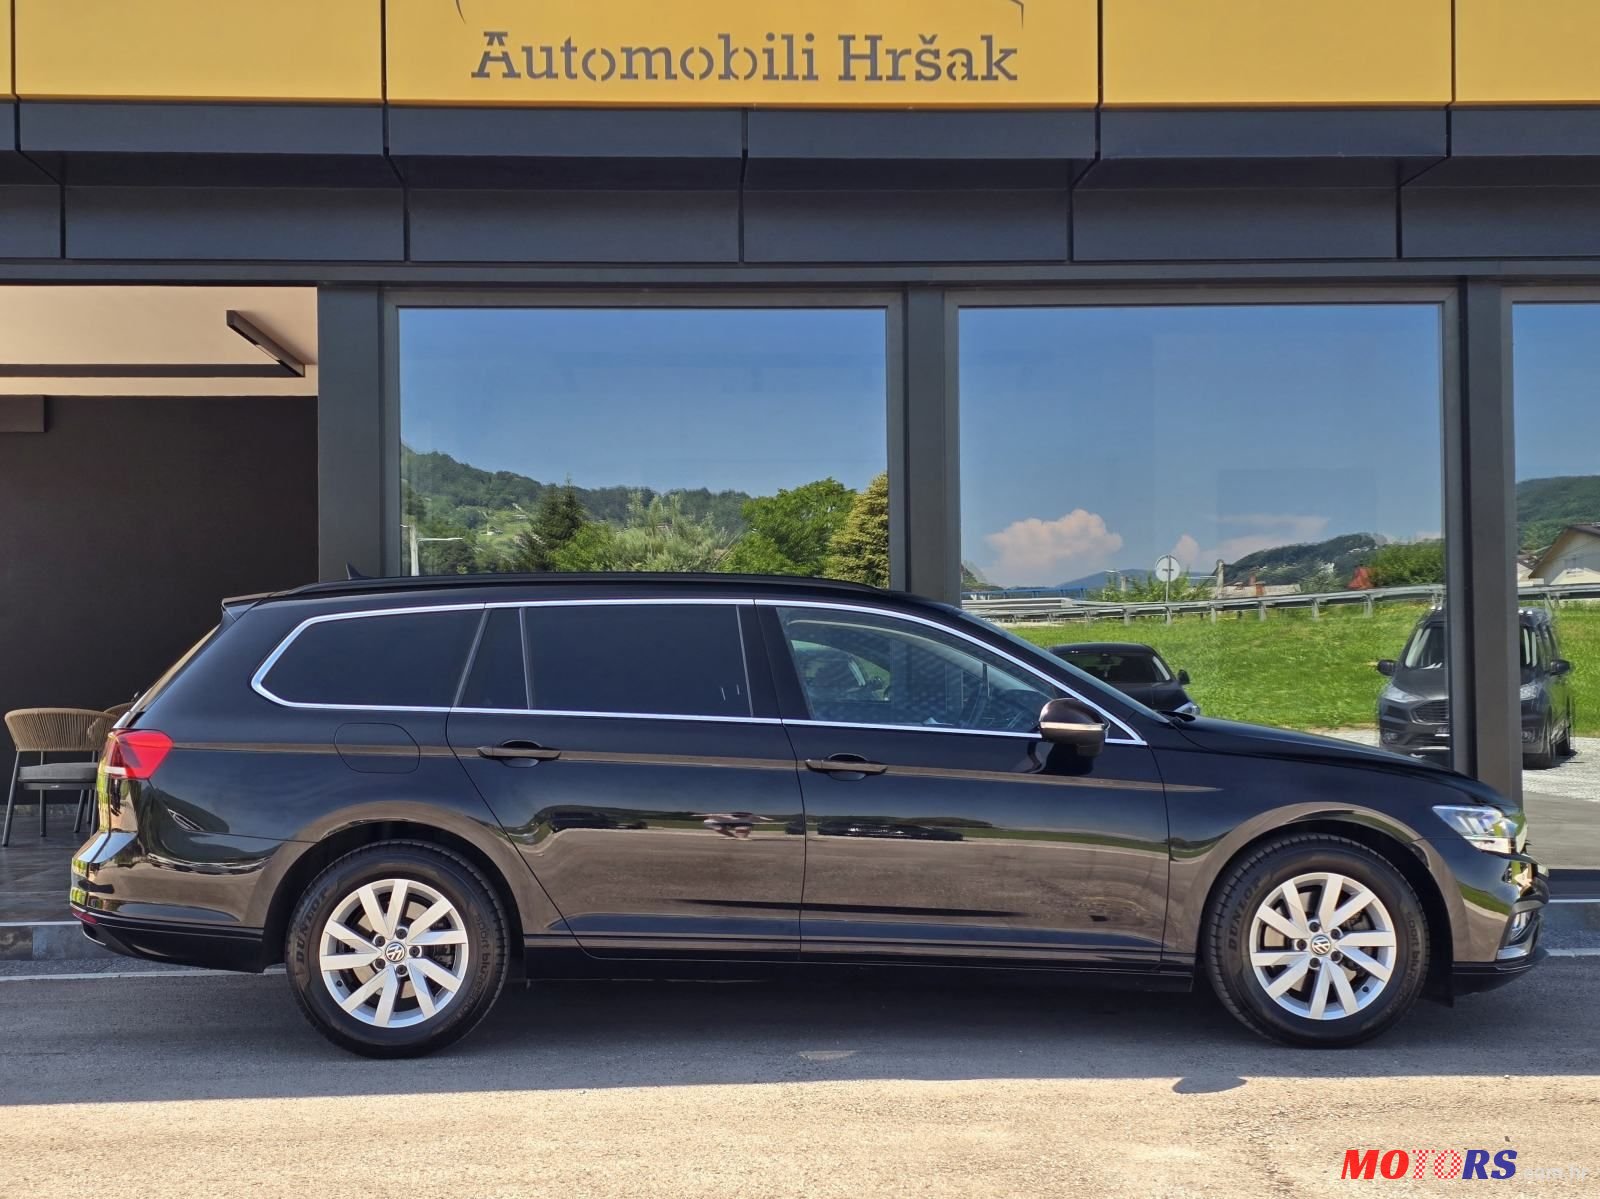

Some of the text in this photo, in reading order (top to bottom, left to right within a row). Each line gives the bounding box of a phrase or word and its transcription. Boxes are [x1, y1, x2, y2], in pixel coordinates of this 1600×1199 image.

[470, 31, 1018, 81] Automobili Hršak
[296, 886, 328, 965] DUNLOP
[1228, 876, 1261, 953] DUNLOP
